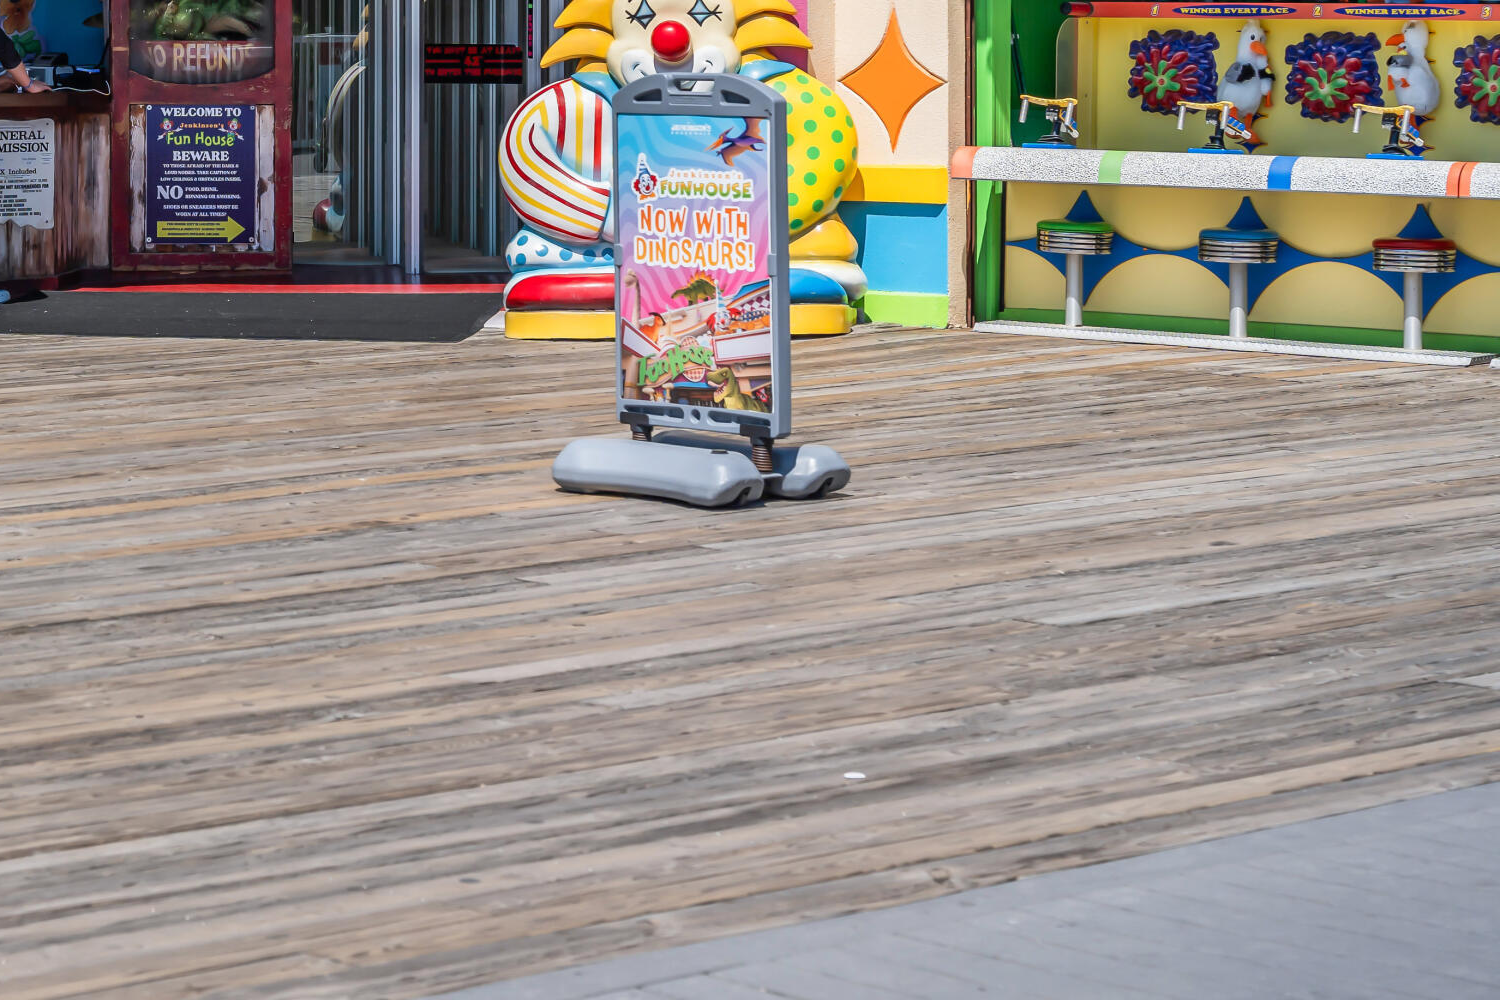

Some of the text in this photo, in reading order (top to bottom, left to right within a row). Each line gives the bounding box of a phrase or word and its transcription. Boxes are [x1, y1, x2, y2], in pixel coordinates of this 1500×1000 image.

[1152, 5, 1159, 16] 1
[1313, 5, 1323, 17] 2
[1344, 8, 1388, 16] WINNER
[1391, 8, 1428, 16] EVERY
[1430, 8, 1461, 16] RACE
[1481, 6, 1491, 19] 3
[160, 107, 242, 116] WELCOME TO
[166, 132, 235, 146] Fun House
[172, 150, 230, 162] BEWARE
[156, 185, 184, 200] NO
[660, 180, 752, 199] FUNHOUSE
[640, 205, 748, 238] NOW WITH
[636, 236, 753, 270] DINOSAURS!
